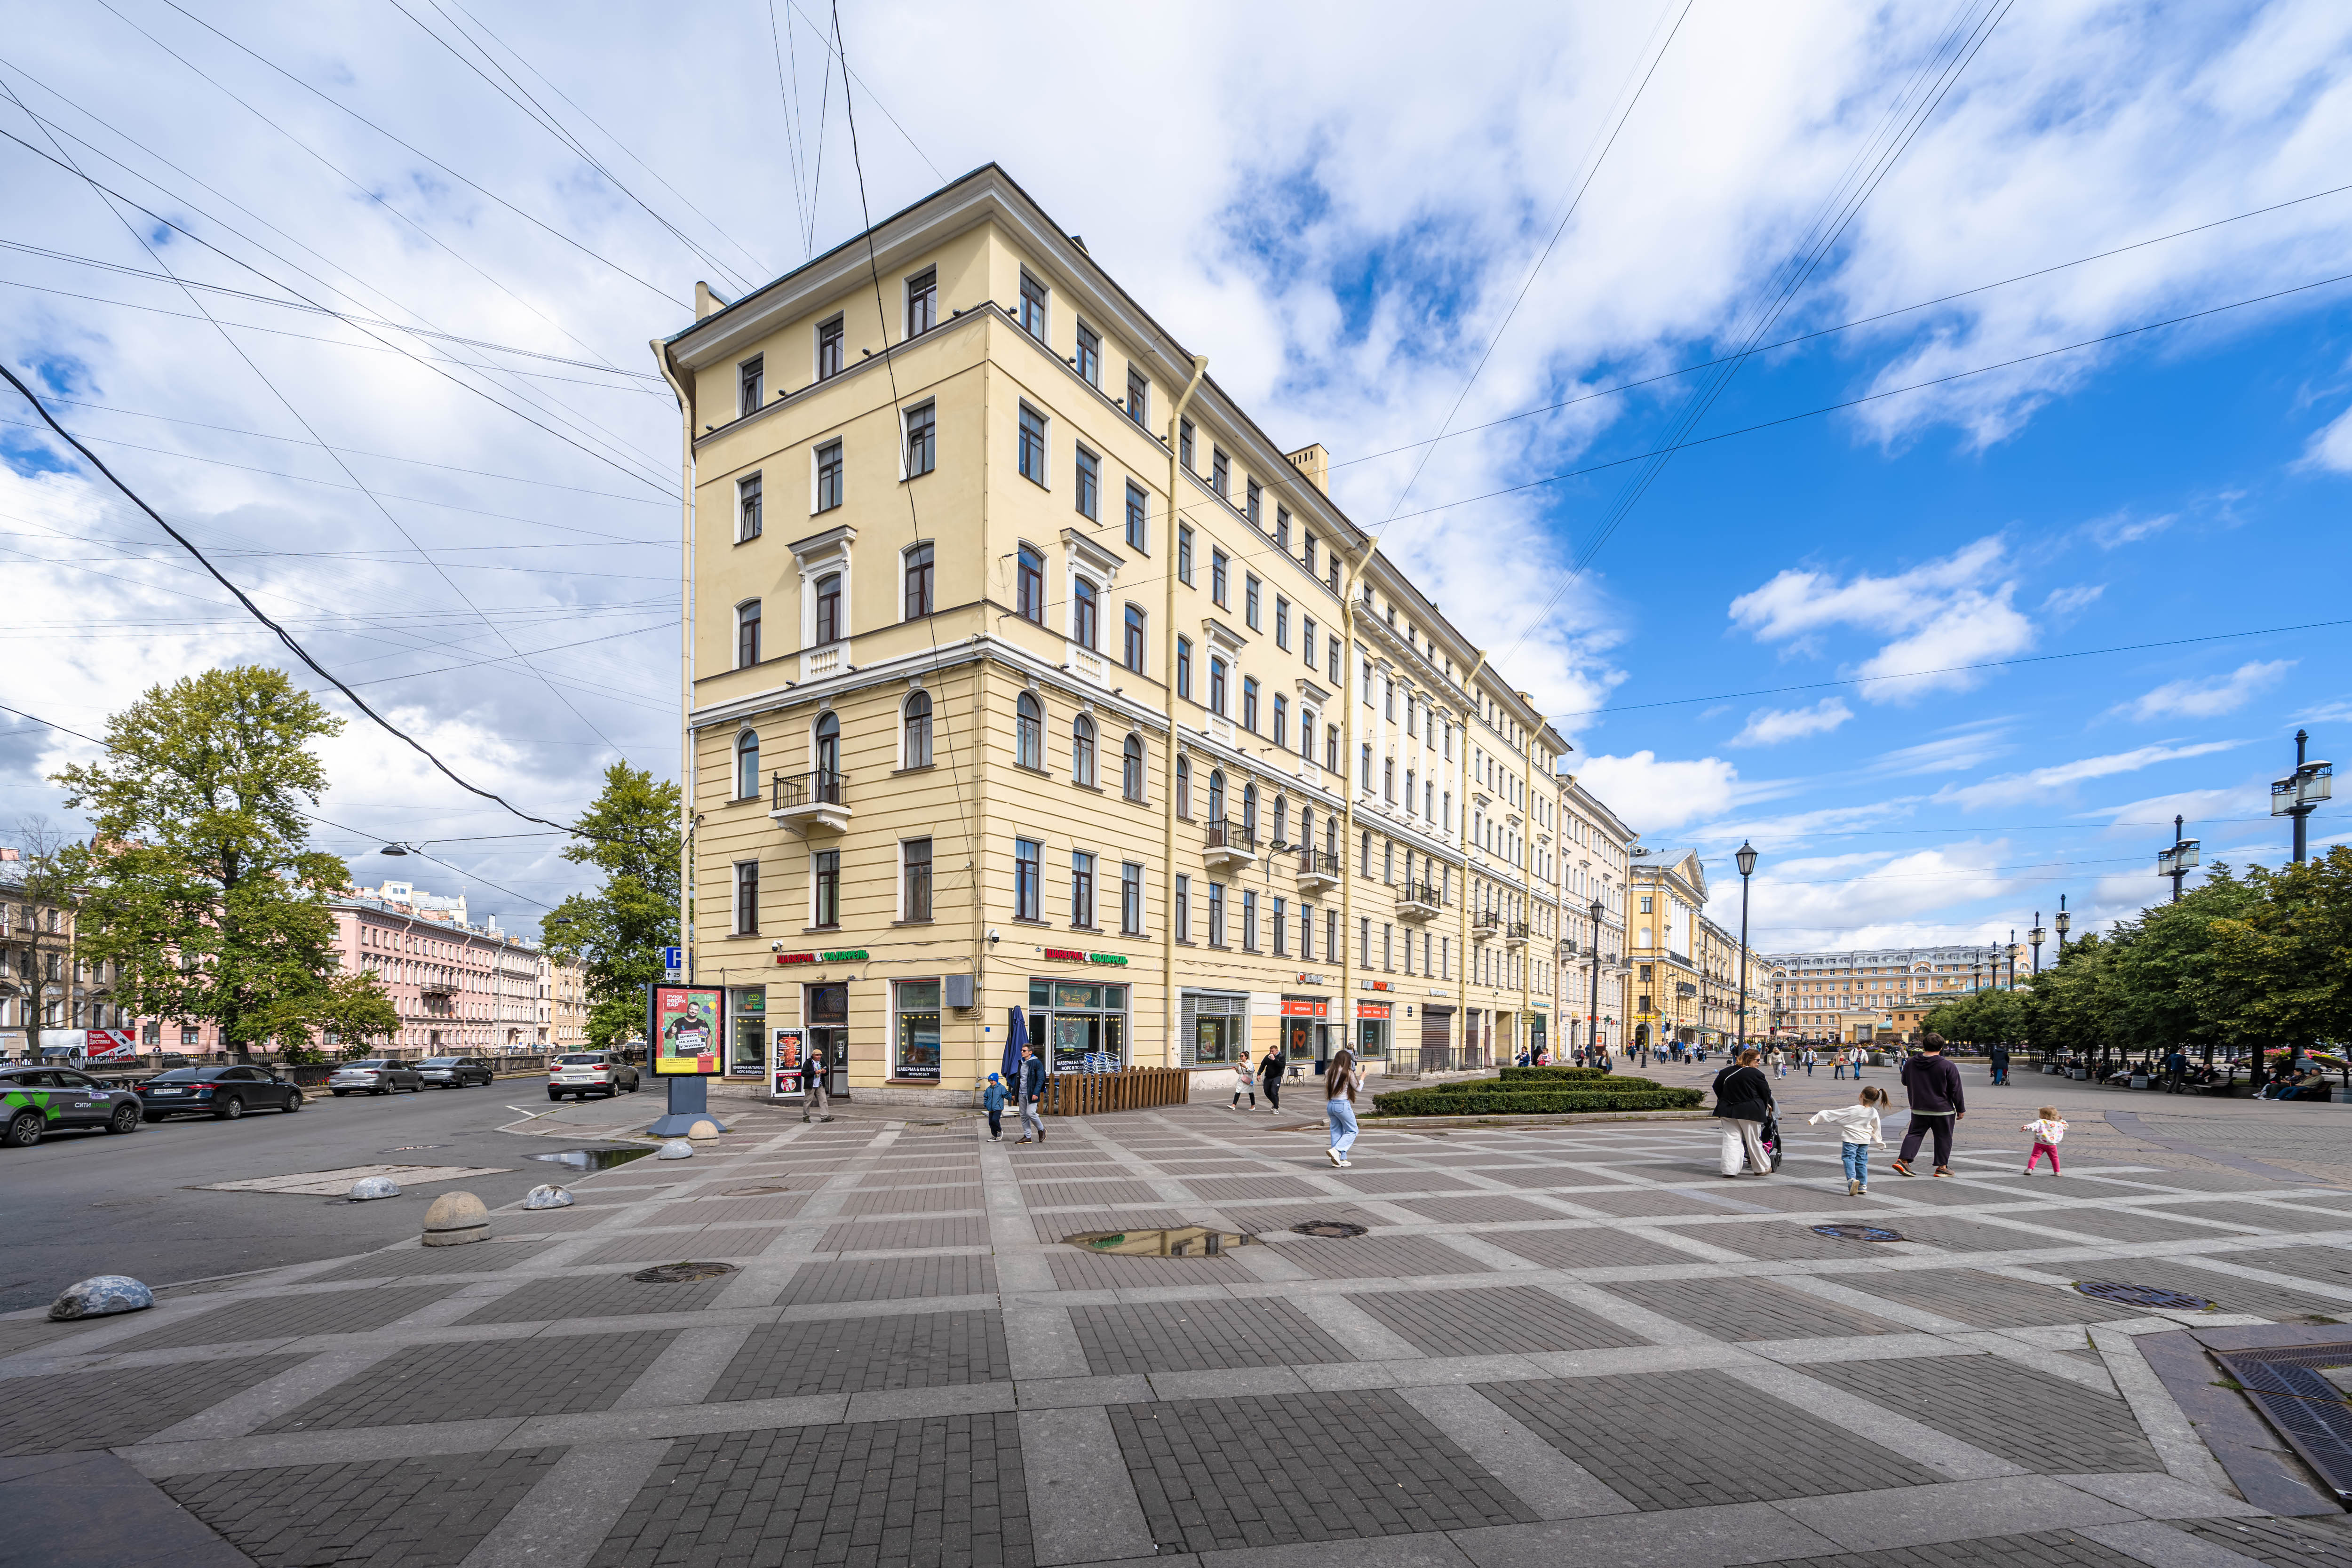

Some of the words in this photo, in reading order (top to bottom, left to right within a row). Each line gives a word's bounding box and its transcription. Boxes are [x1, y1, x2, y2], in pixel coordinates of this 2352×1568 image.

[777, 953, 814, 963] ШАВЕРМА
[815, 952, 823, 962] &
[824, 950, 869, 960] ФАЛАФЕЛЬ
[1045, 948, 1083, 960] ШАВЕРМА
[1084, 952, 1091, 962] &
[1091, 953, 1128, 964] ФАЛАФЕЛЬ
